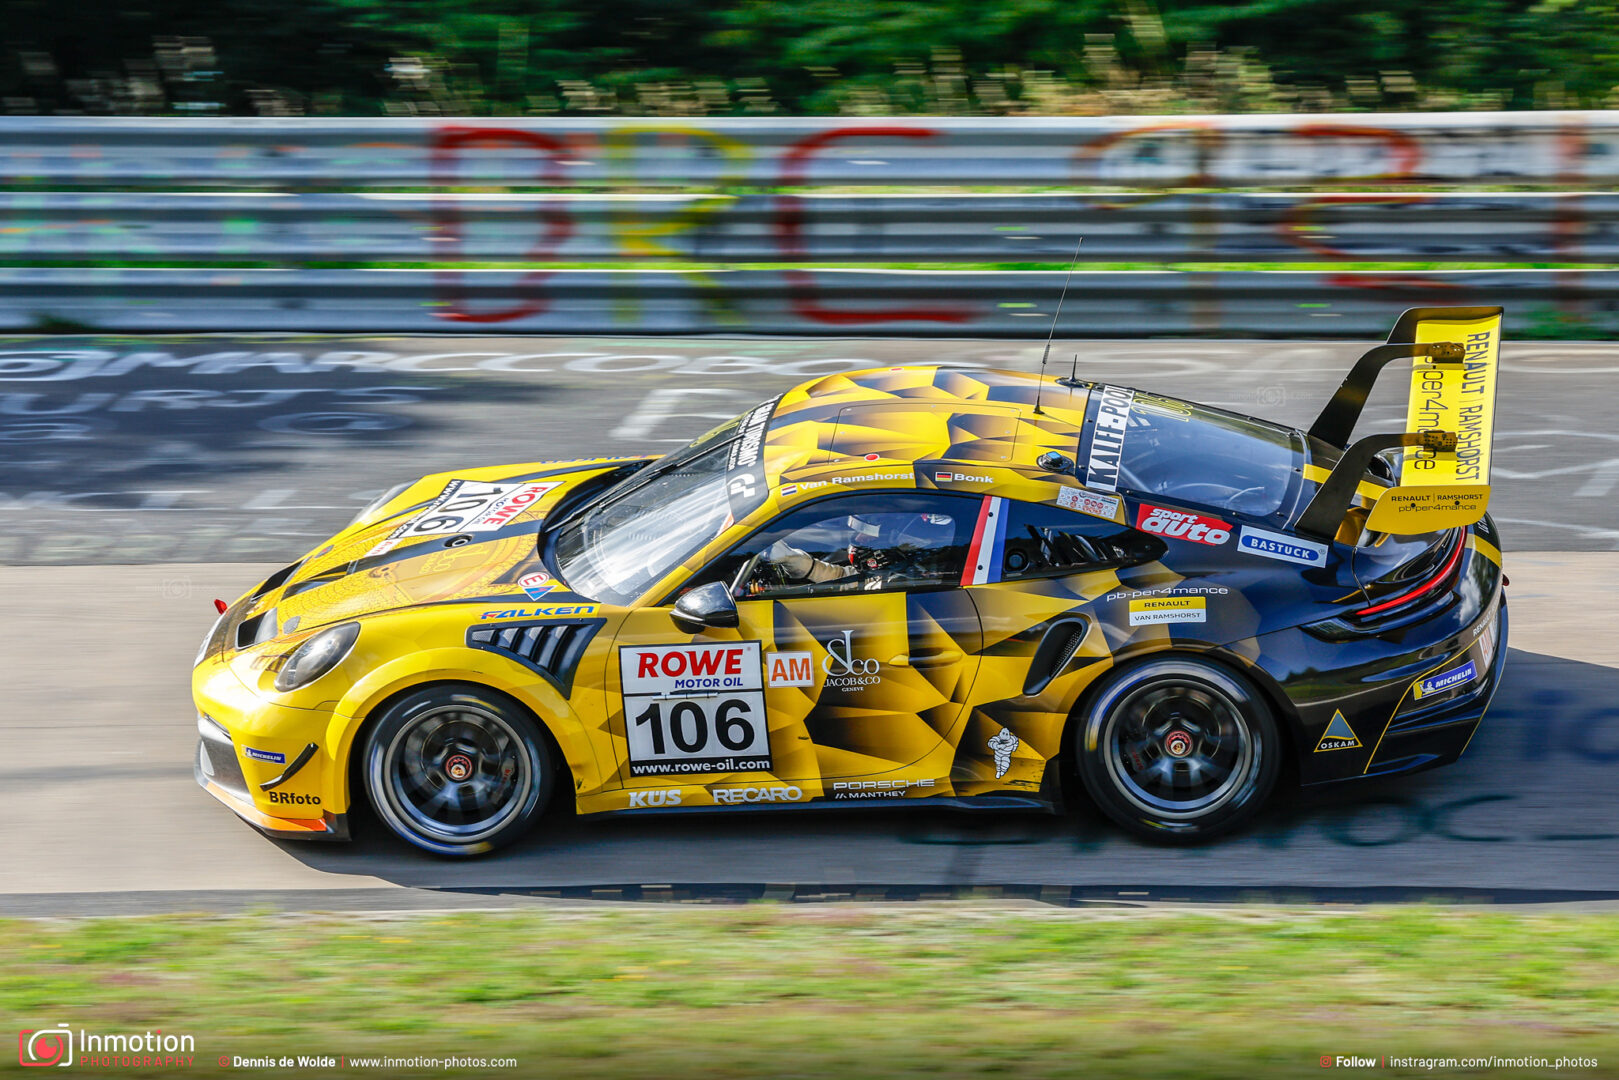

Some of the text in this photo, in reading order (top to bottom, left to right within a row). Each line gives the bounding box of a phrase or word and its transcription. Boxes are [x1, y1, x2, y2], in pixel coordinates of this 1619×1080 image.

[1455, 331, 1491, 481] RENAULT RAMSHORST
[800, 472, 914, 490] Van Ramshorst
[954, 473, 994, 484] Bonk
[413, 487, 503, 533] 106
[483, 486, 550, 526] ROWE
[1150, 508, 1198, 524] sport
[1141, 515, 1231, 546] auto
[1250, 537, 1311, 559] BASTUCK
[1106, 587, 1229, 602] pb-per4mance
[1144, 600, 1191, 608] RENAULT
[480, 606, 595, 620] FALKEN
[1153, 612, 1201, 620] RAMSHORST
[636, 649, 744, 679] ROWE
[771, 658, 811, 682] AM
[674, 677, 743, 689] MOTOR OIL
[823, 676, 881, 688] JACOB&CO
[1435, 668, 1472, 688] MICHELIN
[635, 699, 755, 755] 106
[1320, 740, 1355, 749] OSKAM
[252, 752, 282, 761] MICHELIN
[632, 758, 770, 774] www.rowe-oil.com
[833, 779, 935, 791] PORSCHE
[269, 791, 322, 805] BRfoto
[629, 788, 682, 807] KÜS
[712, 786, 803, 803] RECARO
[848, 790, 906, 799] MANTHEY
